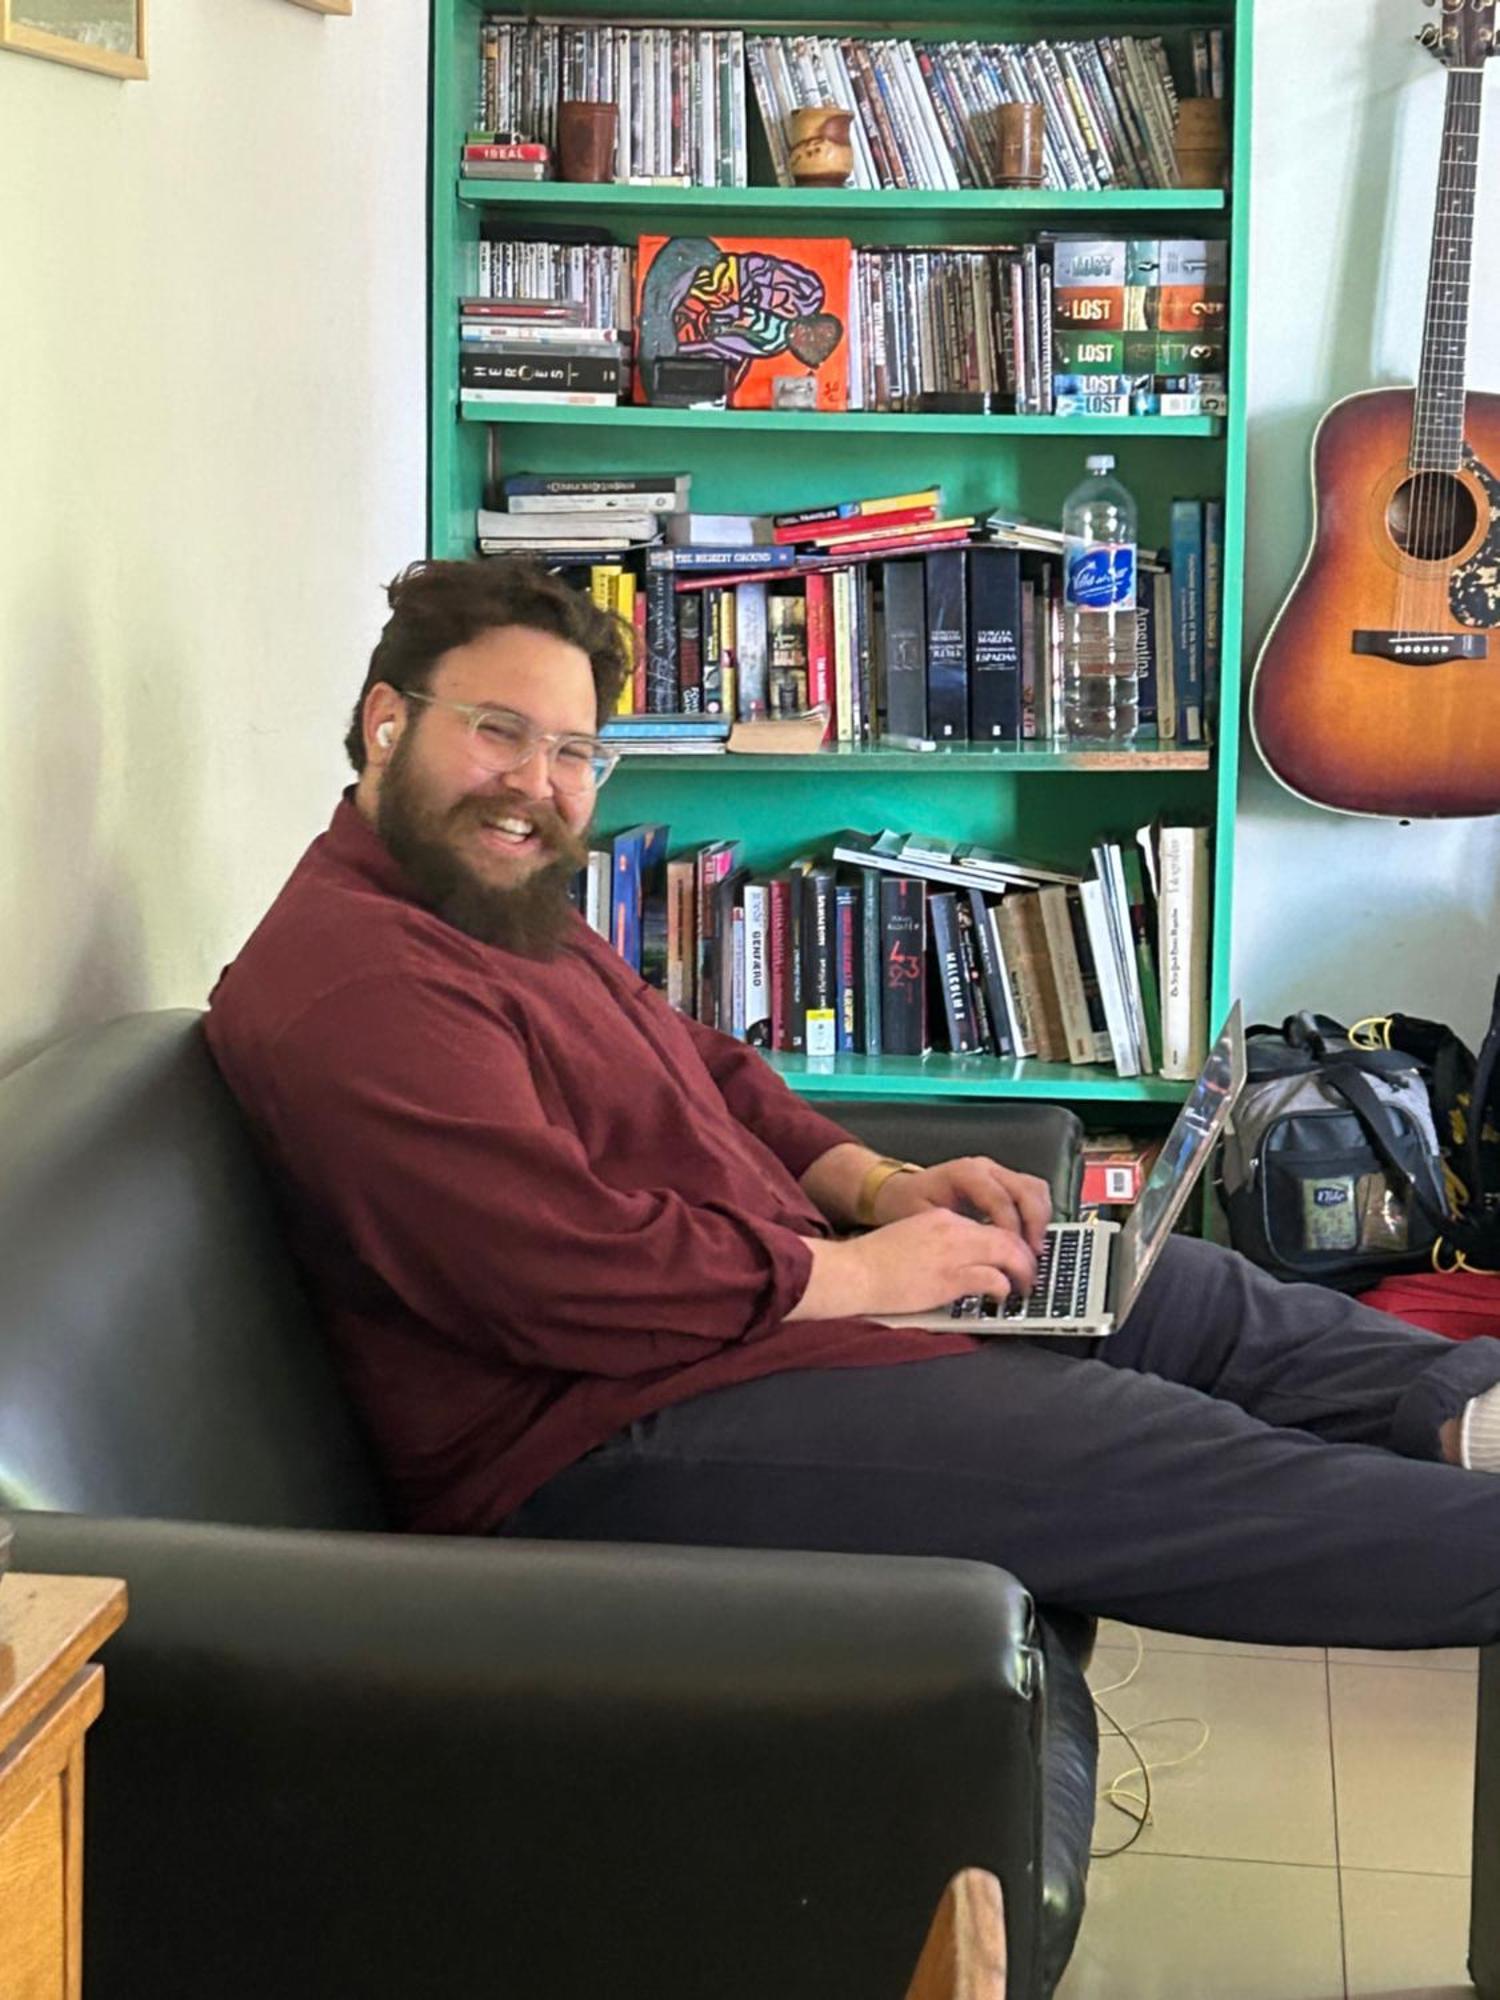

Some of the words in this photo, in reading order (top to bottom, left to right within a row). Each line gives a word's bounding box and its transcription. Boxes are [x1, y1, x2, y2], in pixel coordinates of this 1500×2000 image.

[484, 148, 524, 160] IDEAL
[1073, 299, 1112, 320] LOST
[1078, 344, 1114, 362] LOST
[1083, 376, 1117, 394] LOST
[1086, 396, 1120, 413] LOST
